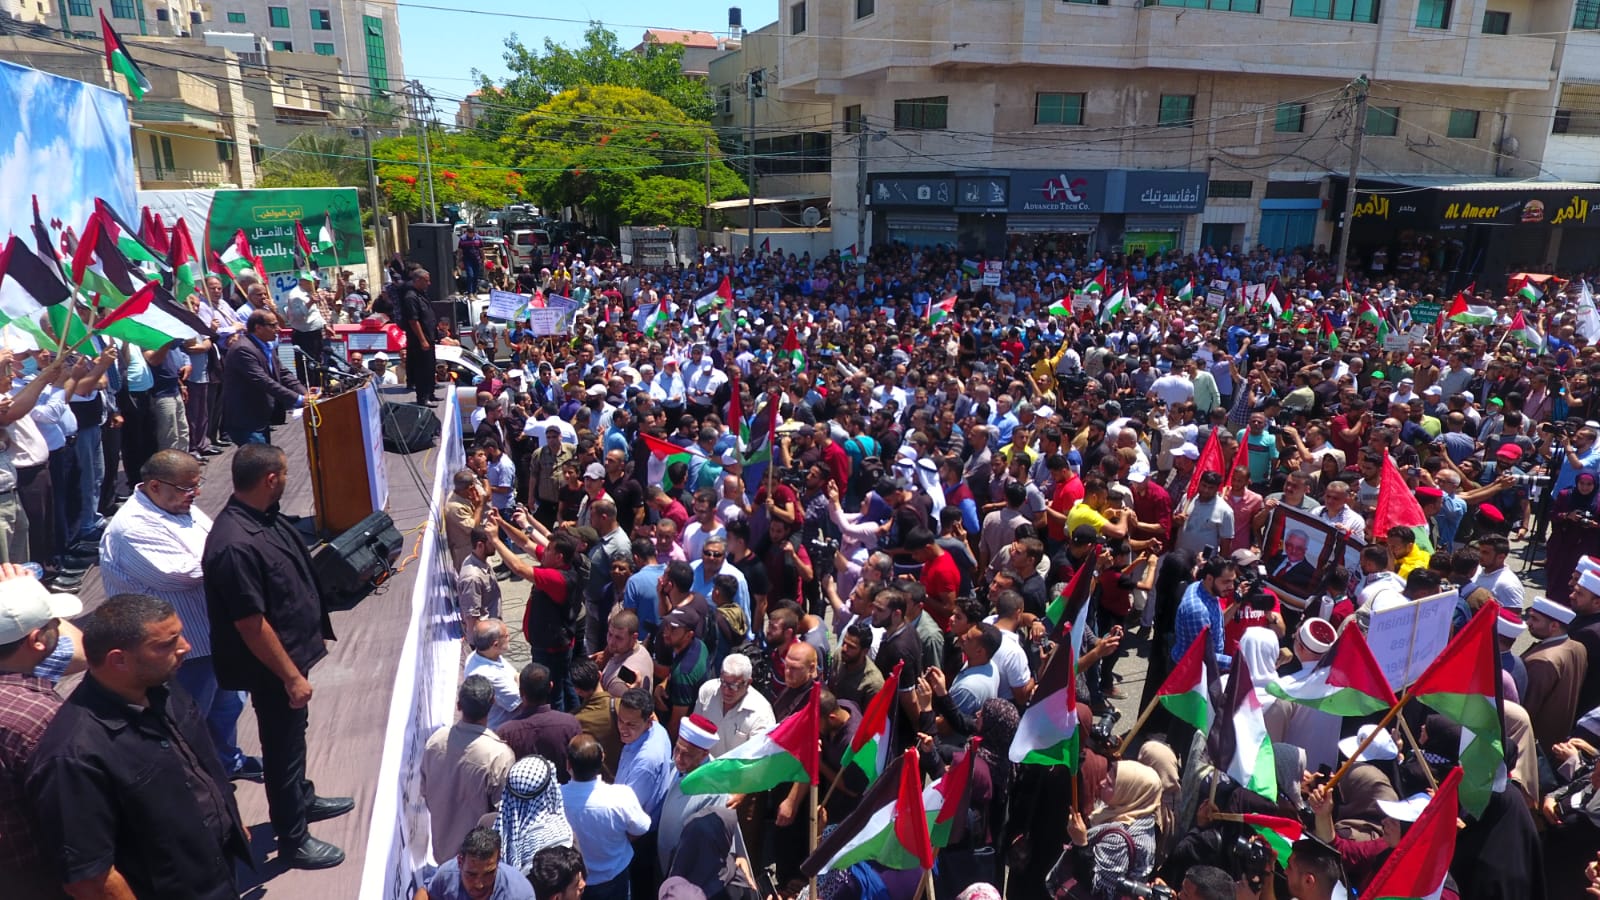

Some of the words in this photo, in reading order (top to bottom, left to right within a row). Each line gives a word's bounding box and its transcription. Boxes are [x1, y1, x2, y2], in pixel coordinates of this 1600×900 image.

[1445, 203, 1459, 219] AL
[1462, 202, 1500, 219] Ameer
[1549, 195, 1589, 224] الأمير
